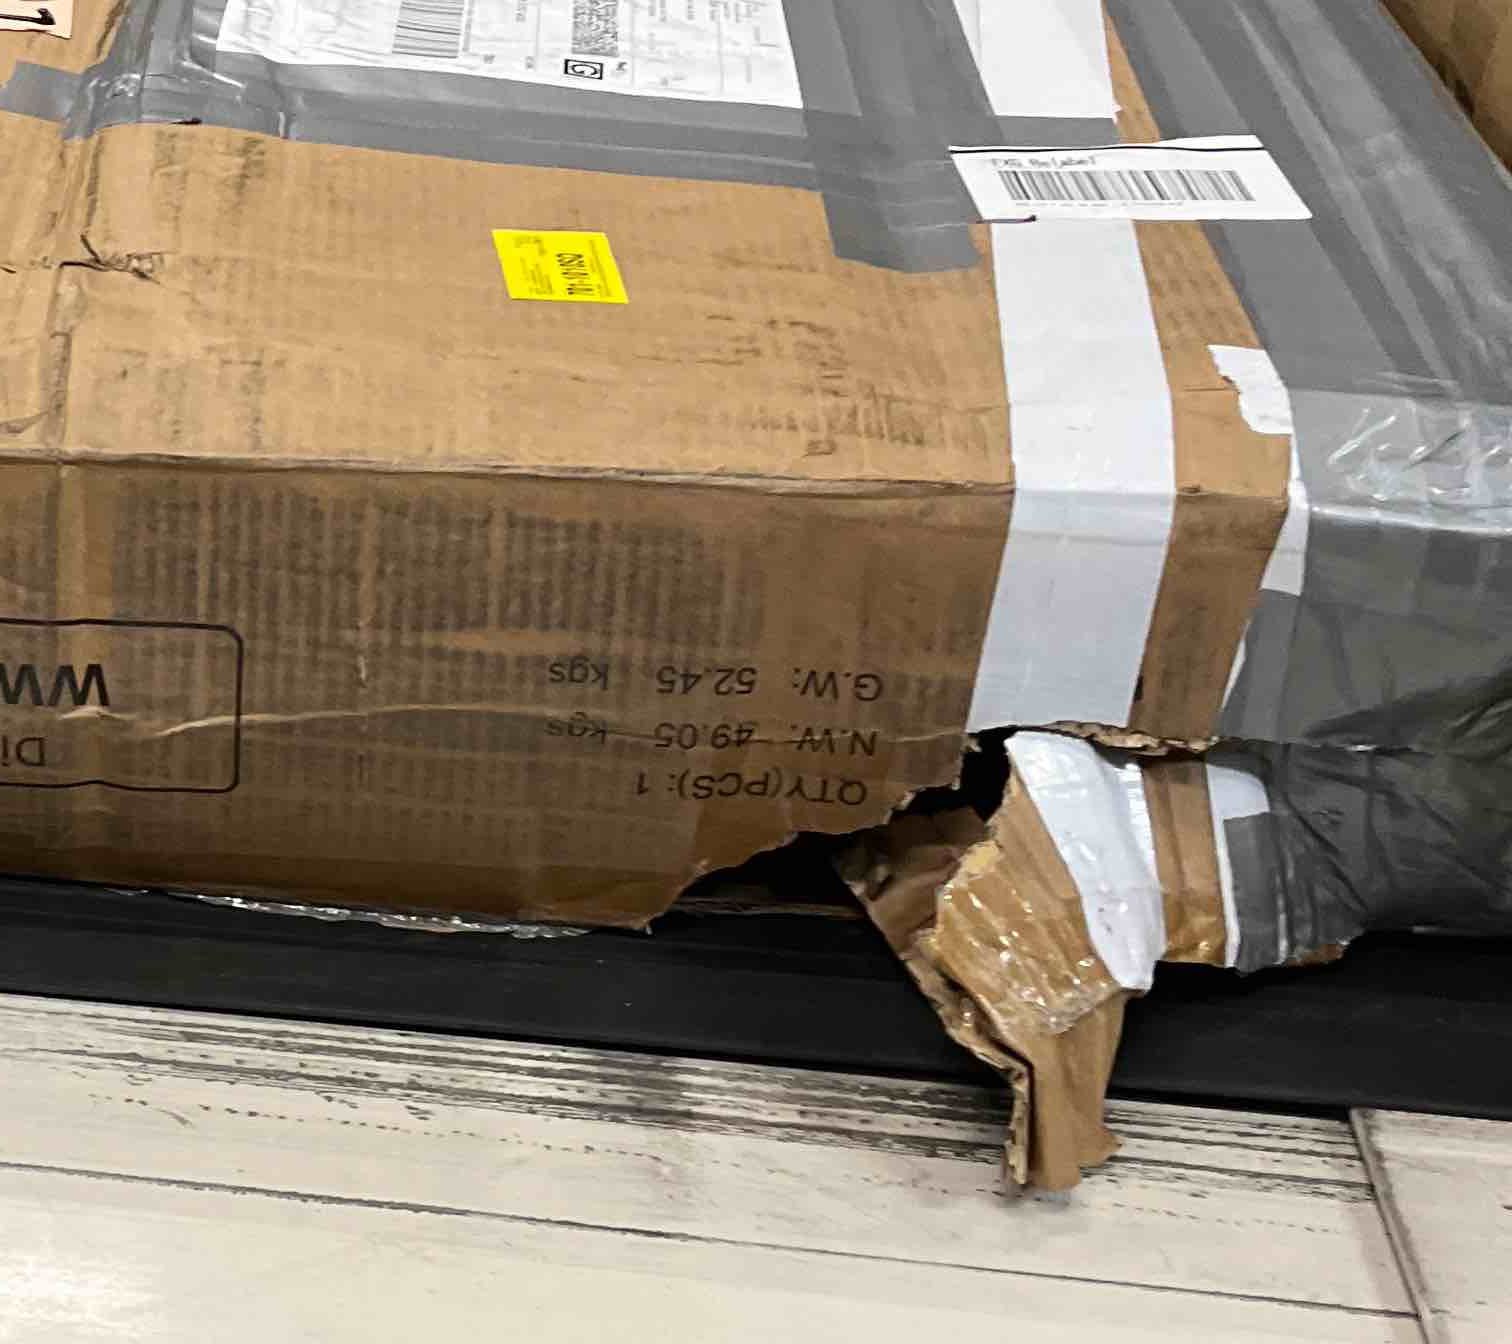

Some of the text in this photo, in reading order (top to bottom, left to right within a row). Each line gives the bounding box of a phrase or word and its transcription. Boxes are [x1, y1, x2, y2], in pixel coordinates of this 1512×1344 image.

[548, 655, 884, 702] G.W: 52.45 kgs
[543, 711, 609, 746] kgs
[653, 721, 758, 752] 49.05
